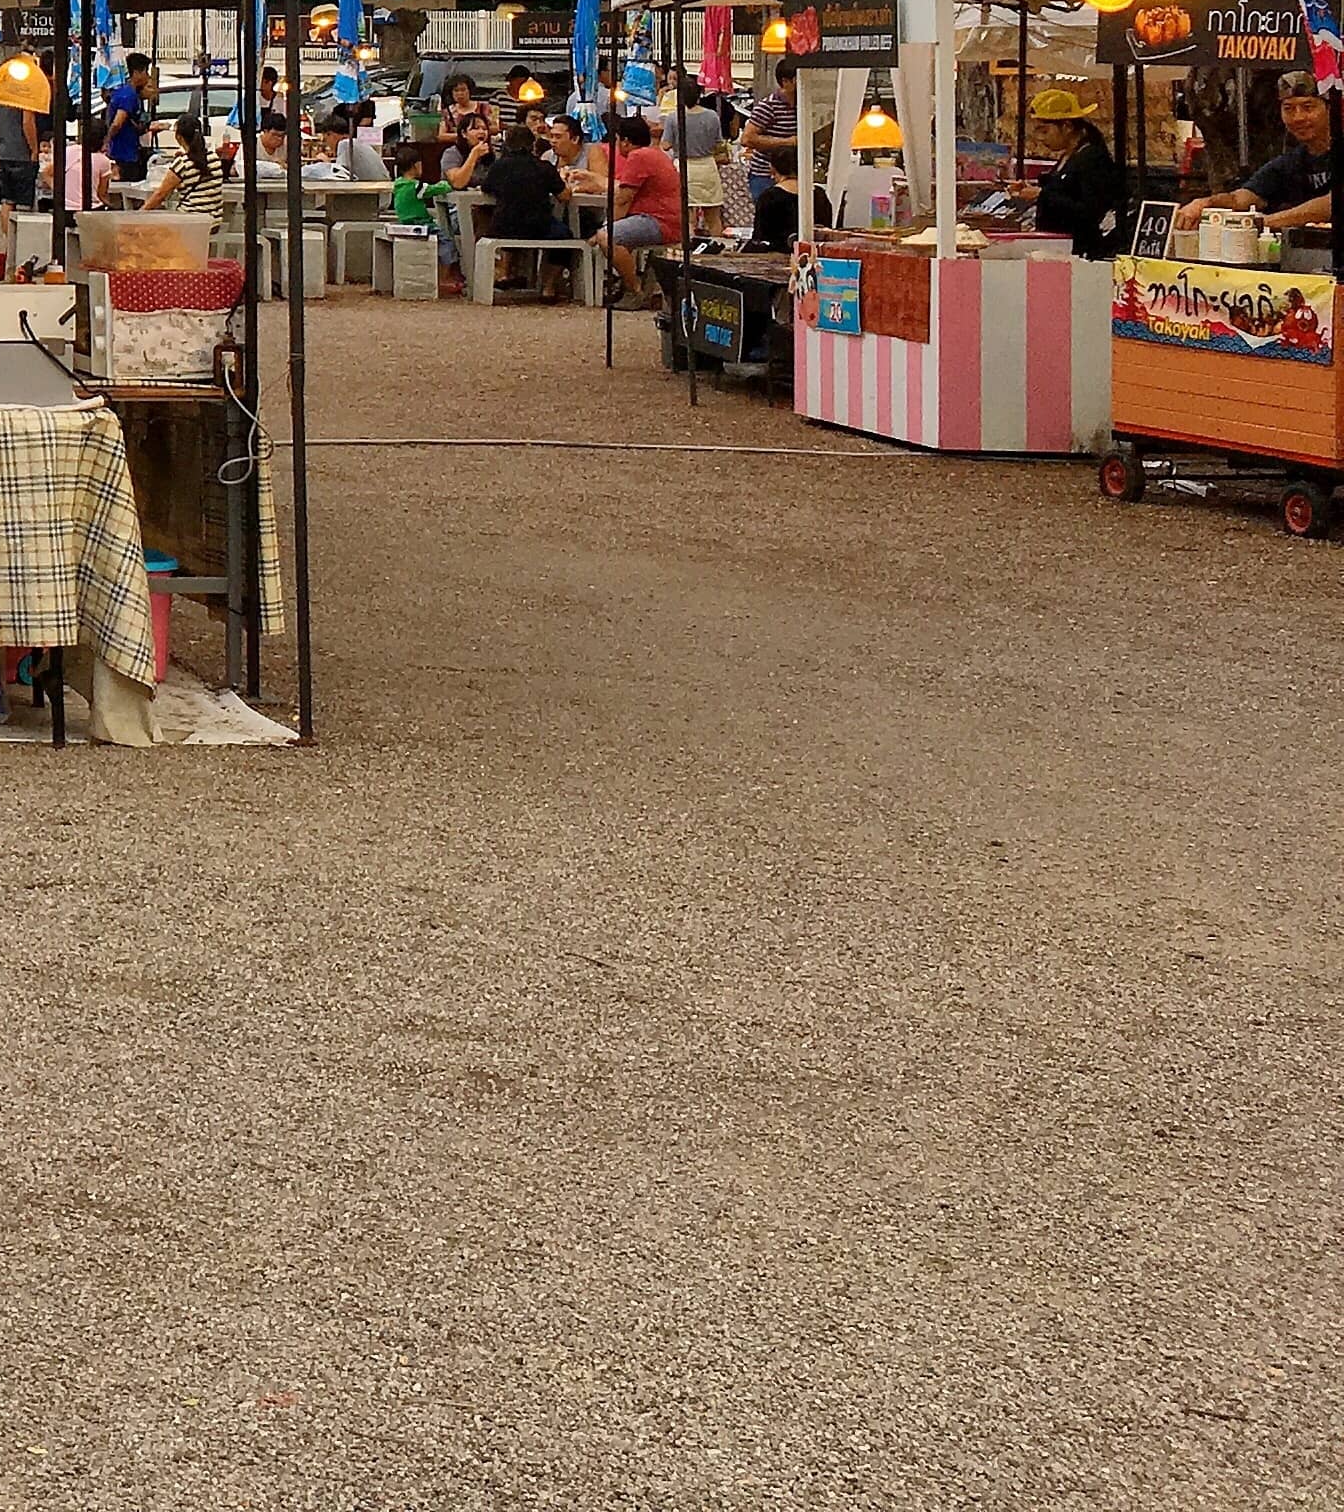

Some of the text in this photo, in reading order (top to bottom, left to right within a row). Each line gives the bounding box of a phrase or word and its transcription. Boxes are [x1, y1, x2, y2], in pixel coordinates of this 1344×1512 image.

[1217, 34, 1297, 61] TAKOYAKI
[1140, 216, 1168, 236] 40
[1148, 316, 1211, 341] Takoyaki
